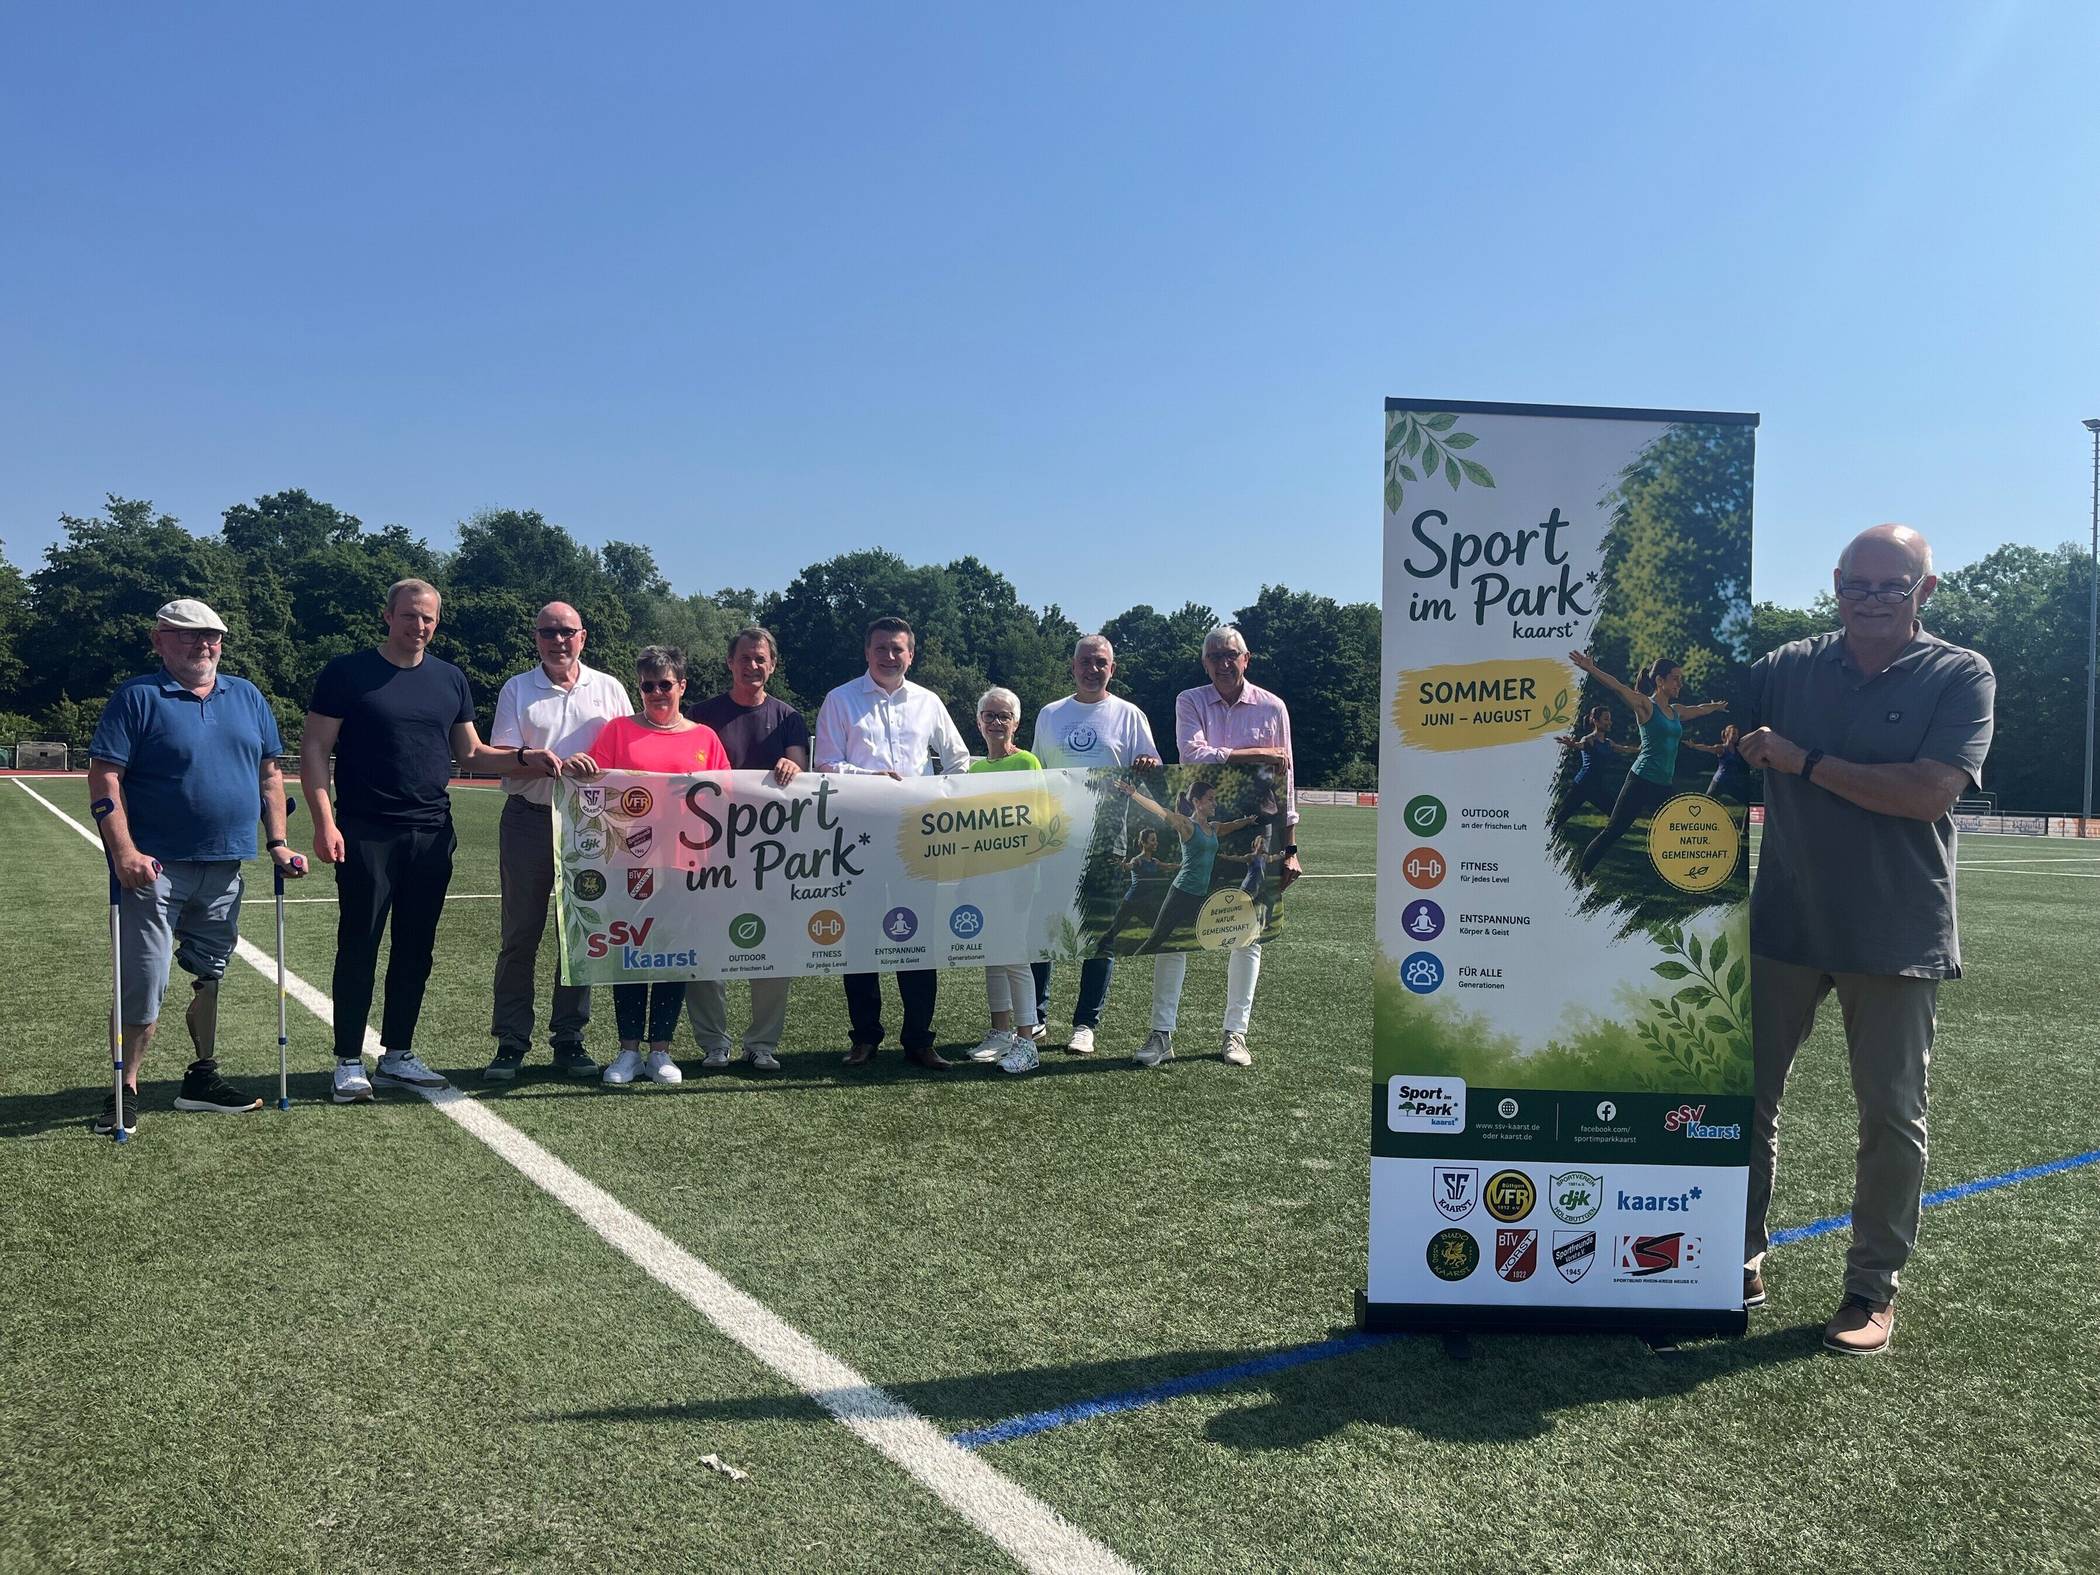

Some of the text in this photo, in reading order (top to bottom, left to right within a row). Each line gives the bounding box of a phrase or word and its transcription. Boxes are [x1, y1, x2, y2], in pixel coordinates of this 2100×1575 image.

[1403, 507, 1570, 590] Sport
[1409, 592, 1456, 622] im
[1419, 677, 1537, 705] SOMMER
[1421, 712, 1454, 727] JUNI
[1472, 709, 1532, 725] AUGUST
[679, 779, 840, 859] Sport
[921, 804, 1032, 835] SOMMER
[1461, 808, 1510, 819] OUTDOOR
[1471, 822, 1483, 830] der
[1485, 822, 1512, 831] frischen
[1514, 823, 1528, 831] Luft
[1669, 822, 1720, 832] BEWEGUNG.
[580, 838, 601, 851] djk
[924, 842, 956, 858] JUNI
[974, 834, 1029, 853] AUGUST
[1680, 836, 1711, 846] NATUR.
[1460, 861, 1499, 872] FITNESS
[686, 860, 738, 892] im
[1460, 874, 1510, 884] für jedes Level
[1459, 914, 1531, 925] ENTSPANNUNG
[586, 916, 655, 958] SSV
[1459, 927, 1484, 937] Körper
[1491, 928, 1510, 936] Geist
[874, 945, 927, 956] ENTSPANNUNG
[950, 943, 983, 952] FÜR ALLE
[728, 953, 767, 963] OUTDOOR
[811, 950, 842, 959] FITNESS
[947, 954, 985, 962] Generationen
[1458, 965, 1503, 978] FÜR ALLE
[1458, 980, 1505, 990] Generationen
[1398, 1085, 1443, 1101] Sport
[1664, 1104, 1706, 1131] SSV
[1482, 1132, 1498, 1140] oder
[1580, 1125, 1631, 1134] facebook.com/
[1686, 1120, 1741, 1140] Kaarst
[1573, 1135, 1637, 1144] sportimparkkaarst
[1442, 1173, 1470, 1200] SG
[1555, 1173, 1597, 1188] SPORTVEREIN
[1491, 1188, 1530, 1205] VFR
[1558, 1189, 1592, 1212] djk
[1438, 1198, 1473, 1213] KAARST
[1440, 1232, 1470, 1241] BUDO
[1498, 1232, 1519, 1247] BTV
[1500, 1234, 1534, 1273] VORST
[1555, 1235, 1595, 1261] Sportfreunde
[1433, 1265, 1472, 1277] KAARST
[1512, 1270, 1527, 1279] 1922
[1565, 1268, 1582, 1276] 1945
